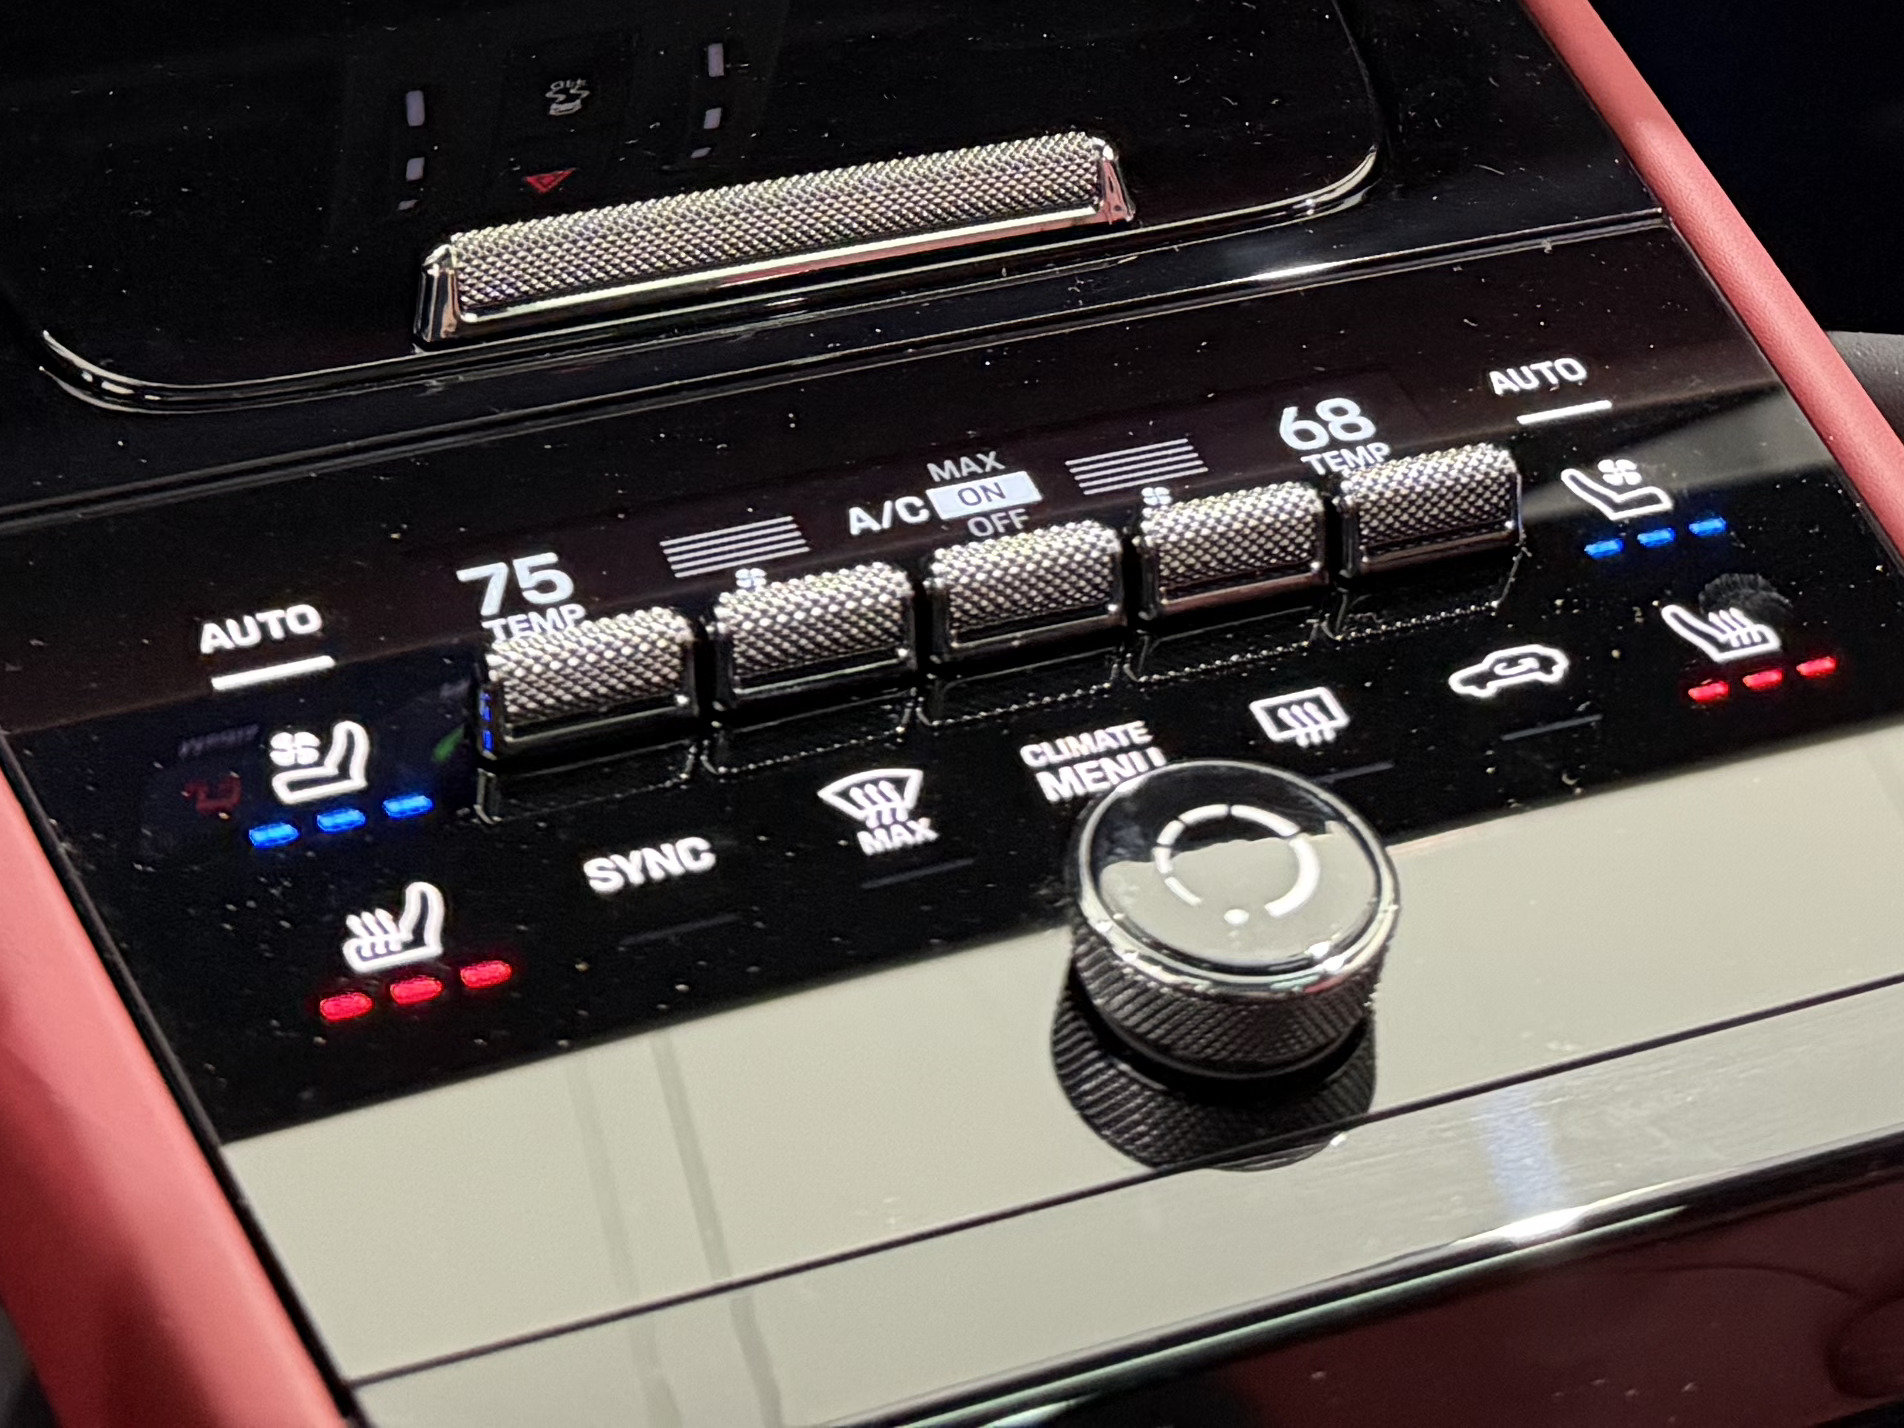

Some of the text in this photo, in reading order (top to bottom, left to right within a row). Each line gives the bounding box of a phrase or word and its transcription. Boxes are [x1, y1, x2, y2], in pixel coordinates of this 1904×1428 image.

[1490, 358, 1586, 395] AUTO
[1279, 397, 1376, 450] 68
[927, 451, 1006, 482] MAX
[1300, 442, 1391, 475] TEMP
[957, 482, 1006, 506] ON
[849, 496, 930, 535] A/C
[967, 508, 1029, 537] OFF
[456, 552, 575, 616] 75
[200, 604, 322, 653] AUTO
[481, 603, 586, 644] TEMP
[1019, 720, 1154, 768] CLIMATE
[858, 822, 939, 855] MAX
[584, 837, 715, 892] SYNC
